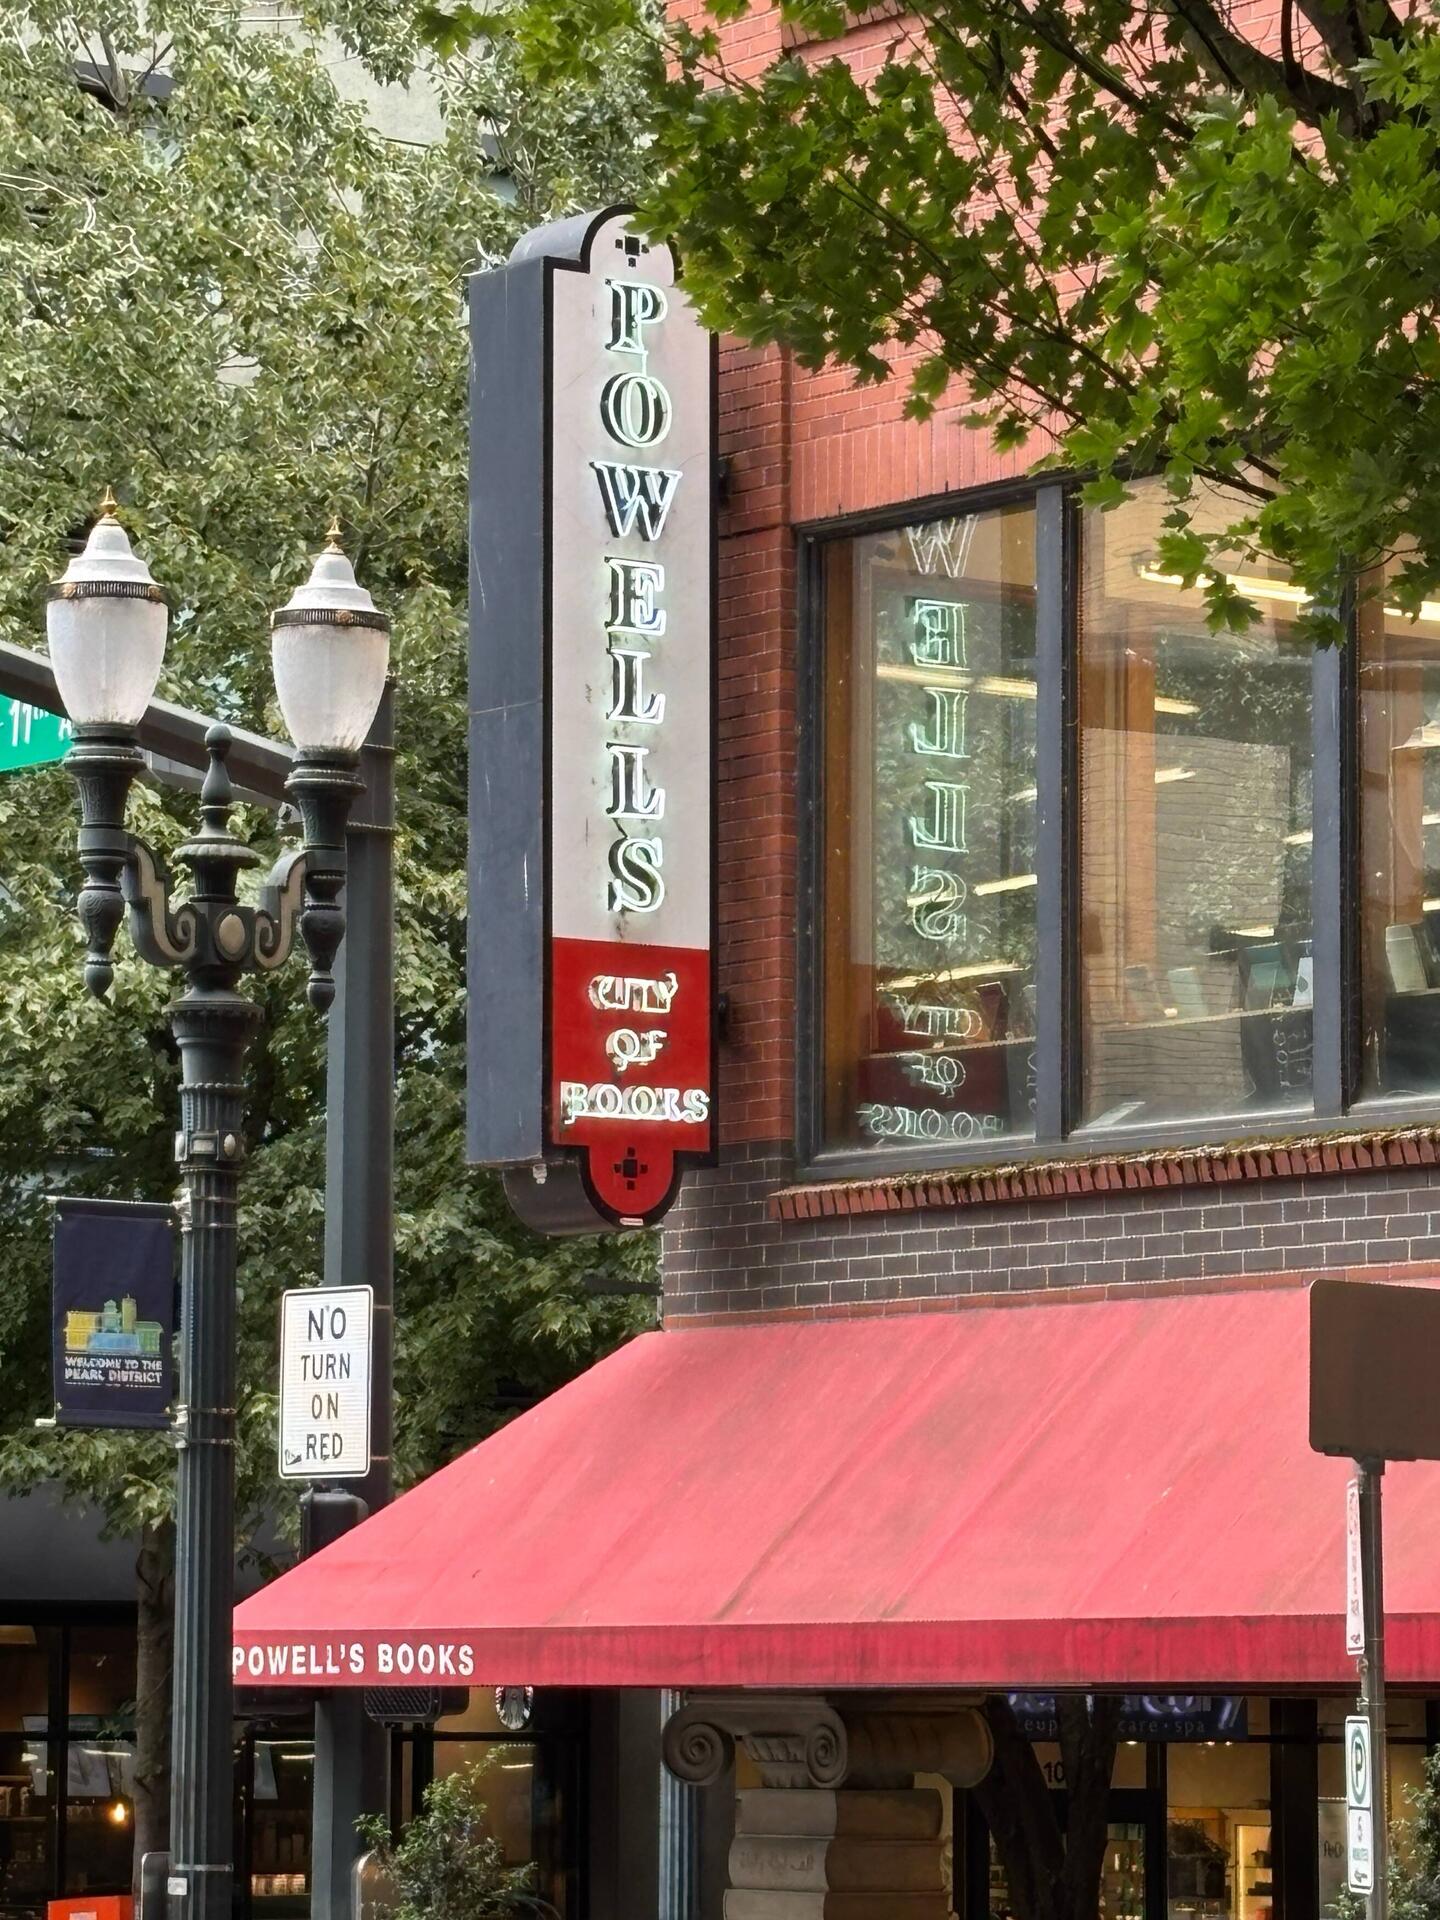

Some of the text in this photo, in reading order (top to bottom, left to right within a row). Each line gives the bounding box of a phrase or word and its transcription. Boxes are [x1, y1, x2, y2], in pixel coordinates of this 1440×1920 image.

[588, 971, 679, 1014] CITY
[605, 1028, 668, 1072] OF
[560, 1080, 711, 1125] BOOKS
[308, 1306, 347, 1341] NO
[64, 1368, 163, 1383] PEARL DISTRICT
[65, 1356, 163, 1371] WELCOME TO THE
[301, 1352, 351, 1382] TURN
[311, 1392, 339, 1420] ON
[306, 1432, 343, 1461] RED
[232, 1643, 474, 1676] POWELL'S BOOKS
[1023, 1719, 1059, 1737] eup
[1174, 1719, 1206, 1737] spa
